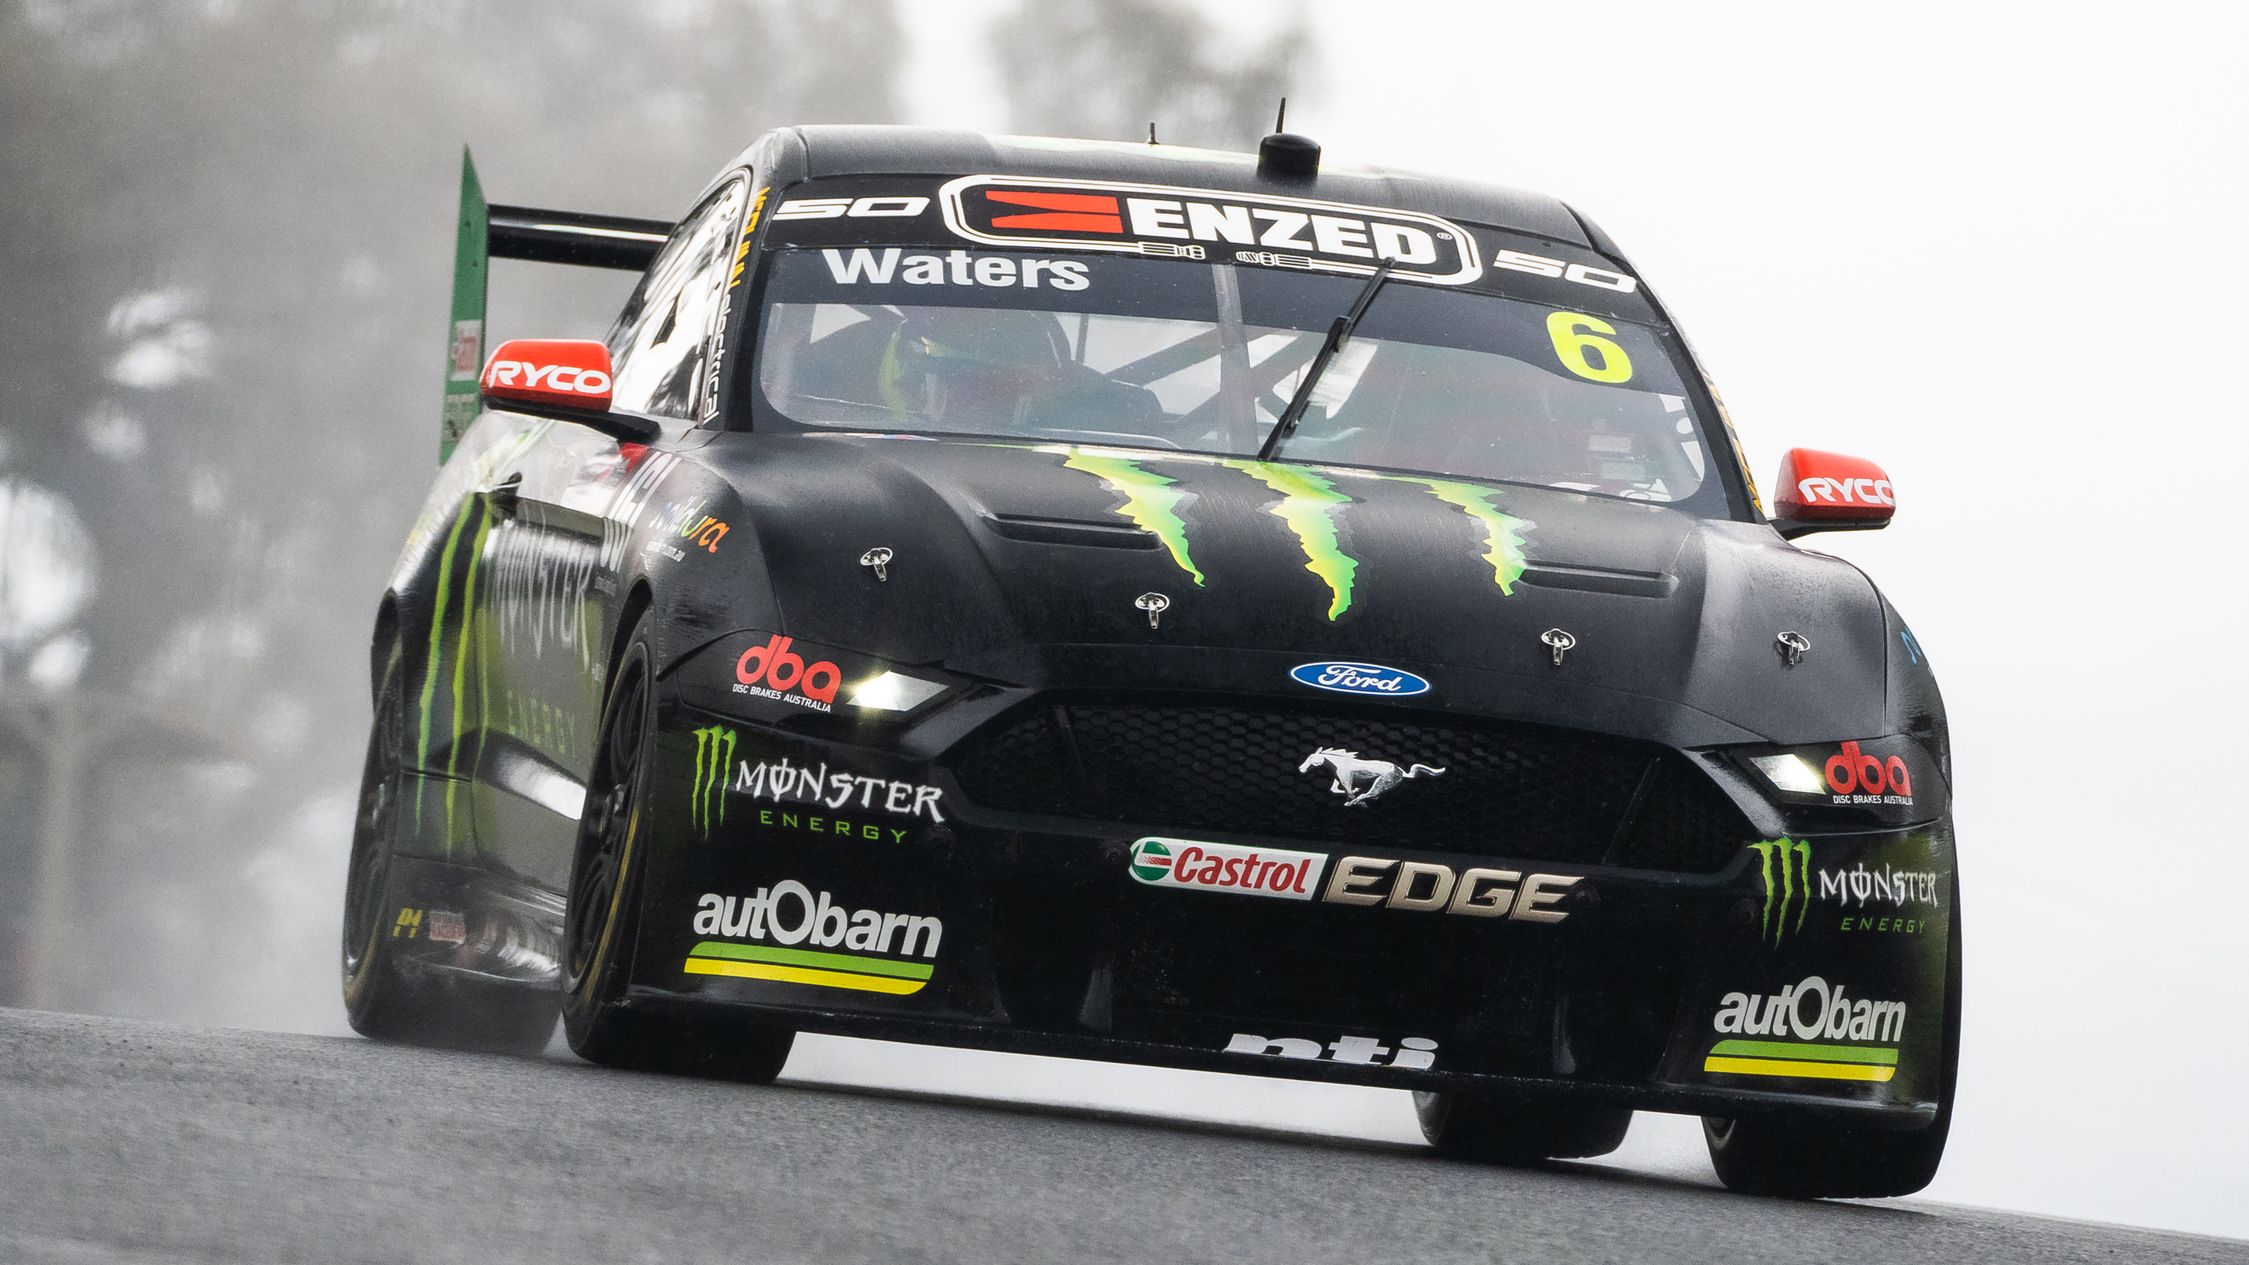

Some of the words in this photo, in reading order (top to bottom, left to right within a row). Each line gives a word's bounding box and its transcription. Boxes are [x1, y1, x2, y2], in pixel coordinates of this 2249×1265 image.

[1127, 198, 1437, 265] ENZED
[821, 248, 1090, 291] Waters
[1546, 311, 1633, 383] 6
[487, 361, 612, 394] RYCO
[736, 634, 842, 704] dba
[1317, 665, 1403, 692] Ford
[732, 683, 749, 694] DISC
[749, 686, 783, 701] BRAKES
[783, 693, 832, 713] AUSTRALIA
[1824, 741, 1912, 797] dba
[1832, 795, 1851, 804] DISC
[1852, 795, 1882, 804] BRAKES
[760, 810, 907, 843] ENERGY
[1173, 846, 1312, 893] Castrol
[1321, 856, 1585, 924] EDGE
[1840, 917, 1927, 934] ENERGY
